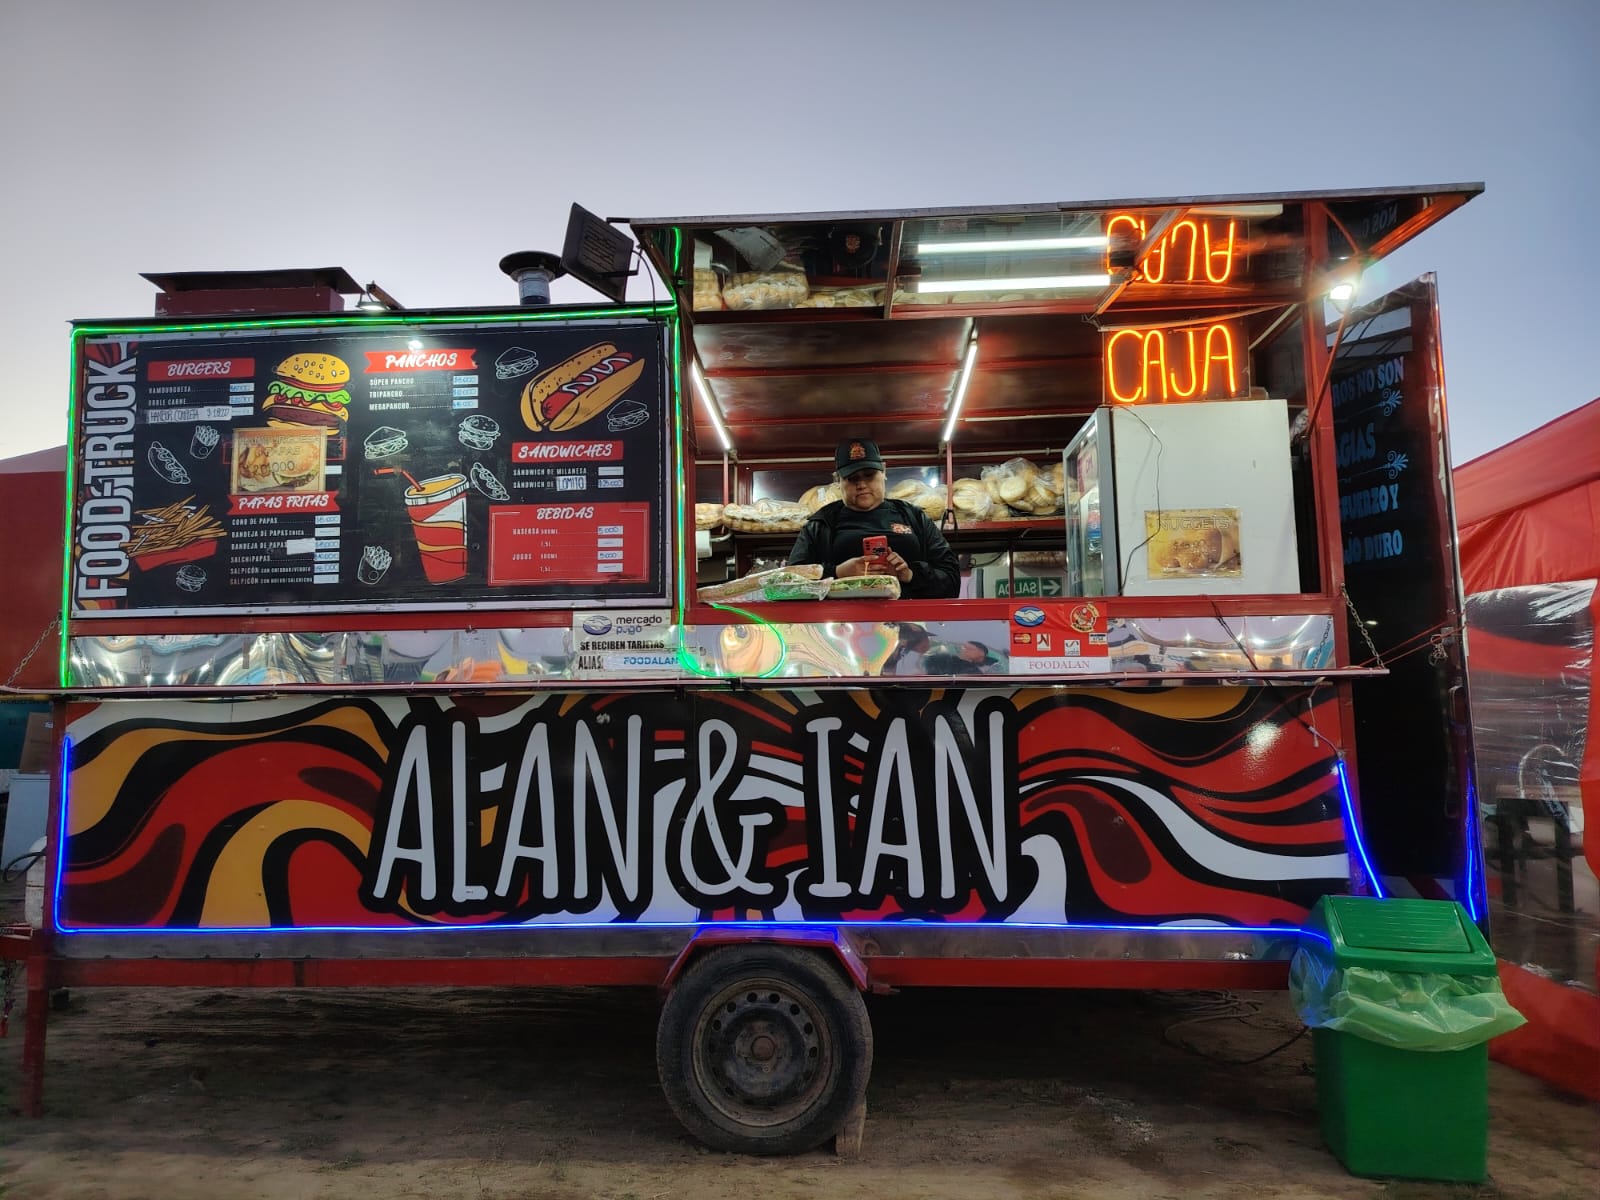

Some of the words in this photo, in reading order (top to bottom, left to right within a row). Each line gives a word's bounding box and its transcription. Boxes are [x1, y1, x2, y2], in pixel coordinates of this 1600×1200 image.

[385, 353, 458, 369] PANCHOS
[1107, 324, 1236, 403] CAJA
[167, 361, 231, 377] BURGERS
[1377, 355, 1405, 390] SON
[390, 377, 415, 386] PANCHO
[369, 390, 403, 398] TRIPANCHO
[369, 402, 410, 411] MEGAPANCHO
[83, 357, 137, 486] TRUCK
[518, 443, 613, 459] SÁNDWICHES
[556, 467, 587, 475] MILANESA
[239, 496, 283, 510] PAPAS
[286, 494, 330, 508] FRITAS
[536, 507, 595, 520] BEBIDAS
[258, 517, 278, 525] PAPAS
[231, 531, 259, 539] BANDEJA
[269, 529, 289, 537] PAPAS
[77, 498, 134, 598] FOOD
[1364, 529, 1403, 561] DURO
[616, 615, 663, 624] mercado
[580, 641, 590, 650] SE
[591, 641, 626, 650] RECIBEN
[624, 656, 679, 665] FOODALAN
[1028, 660, 1090, 670] FOODALAN
[372, 714, 643, 902] ALAN
[679, 718, 774, 896] &
[805, 710, 1009, 903] IAN
